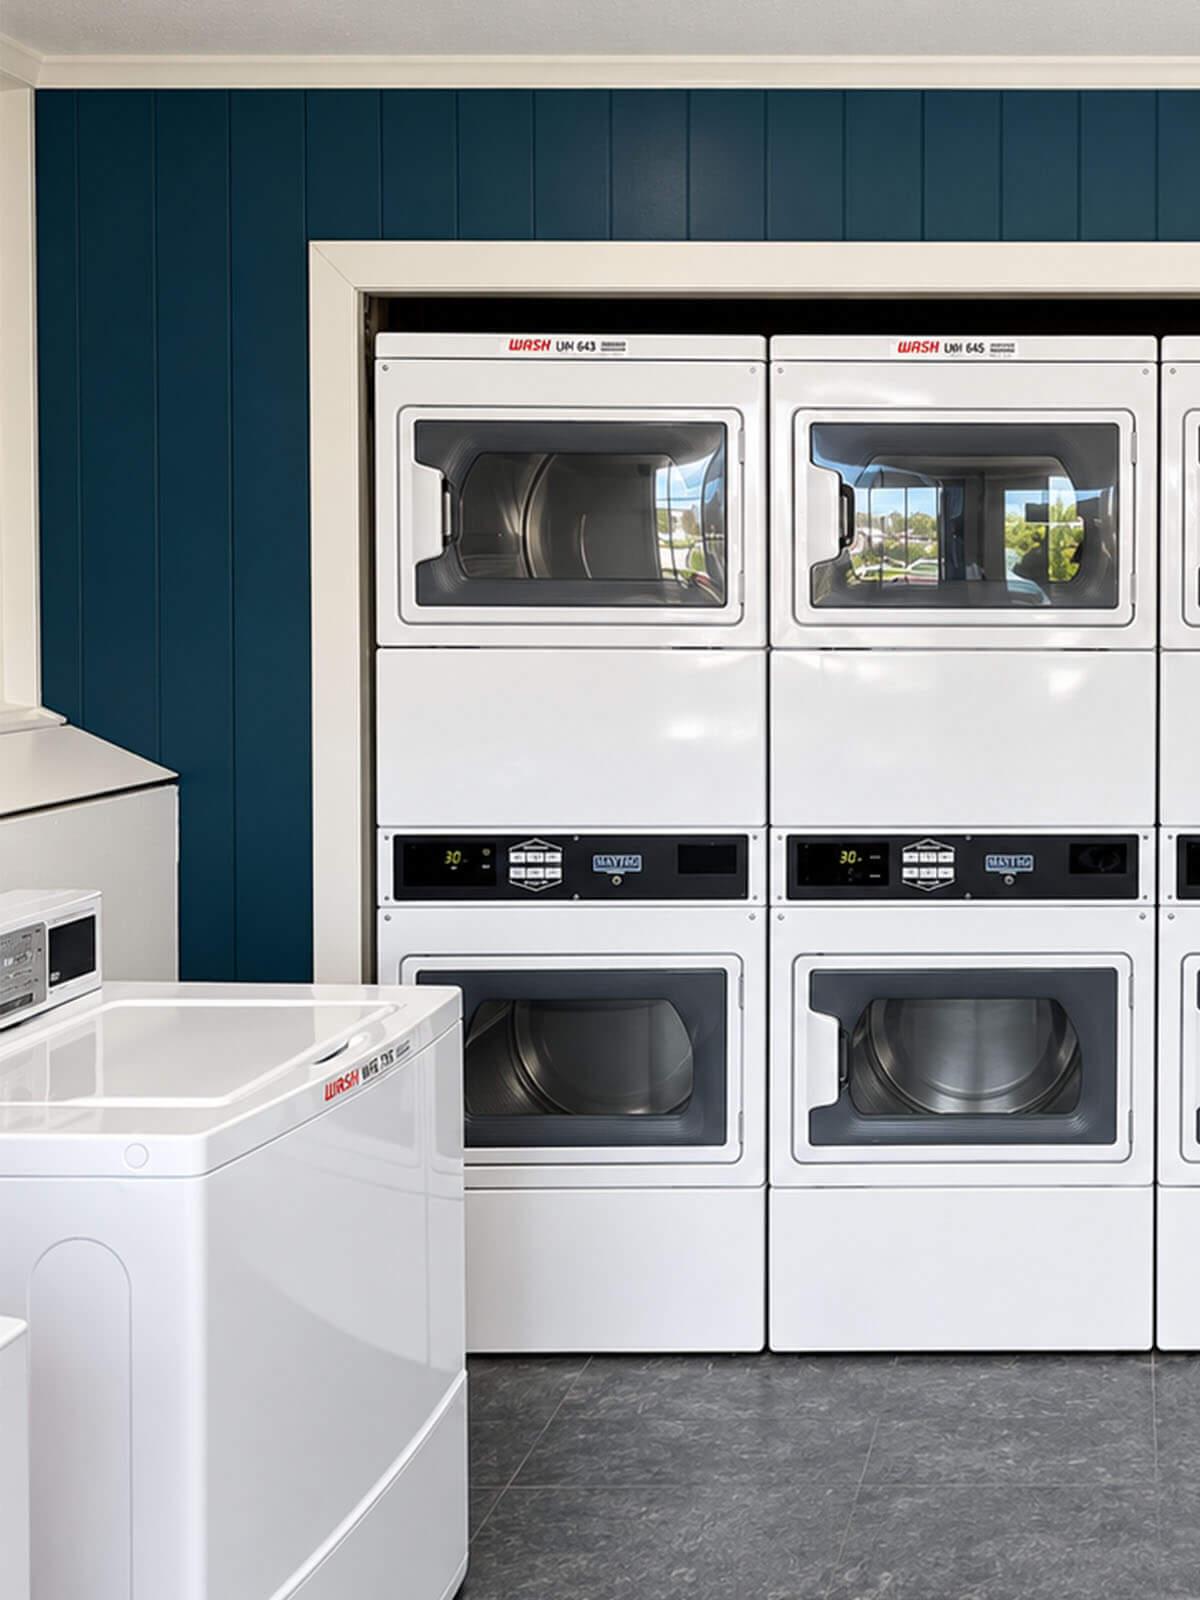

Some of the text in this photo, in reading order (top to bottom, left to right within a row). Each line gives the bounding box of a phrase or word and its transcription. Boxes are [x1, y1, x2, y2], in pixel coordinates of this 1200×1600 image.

[508, 339, 552, 352] WASH
[897, 340, 941, 353] WASH
[444, 850, 462, 864] 30
[839, 850, 857, 864] 30
[324, 1069, 360, 1102] WASH
